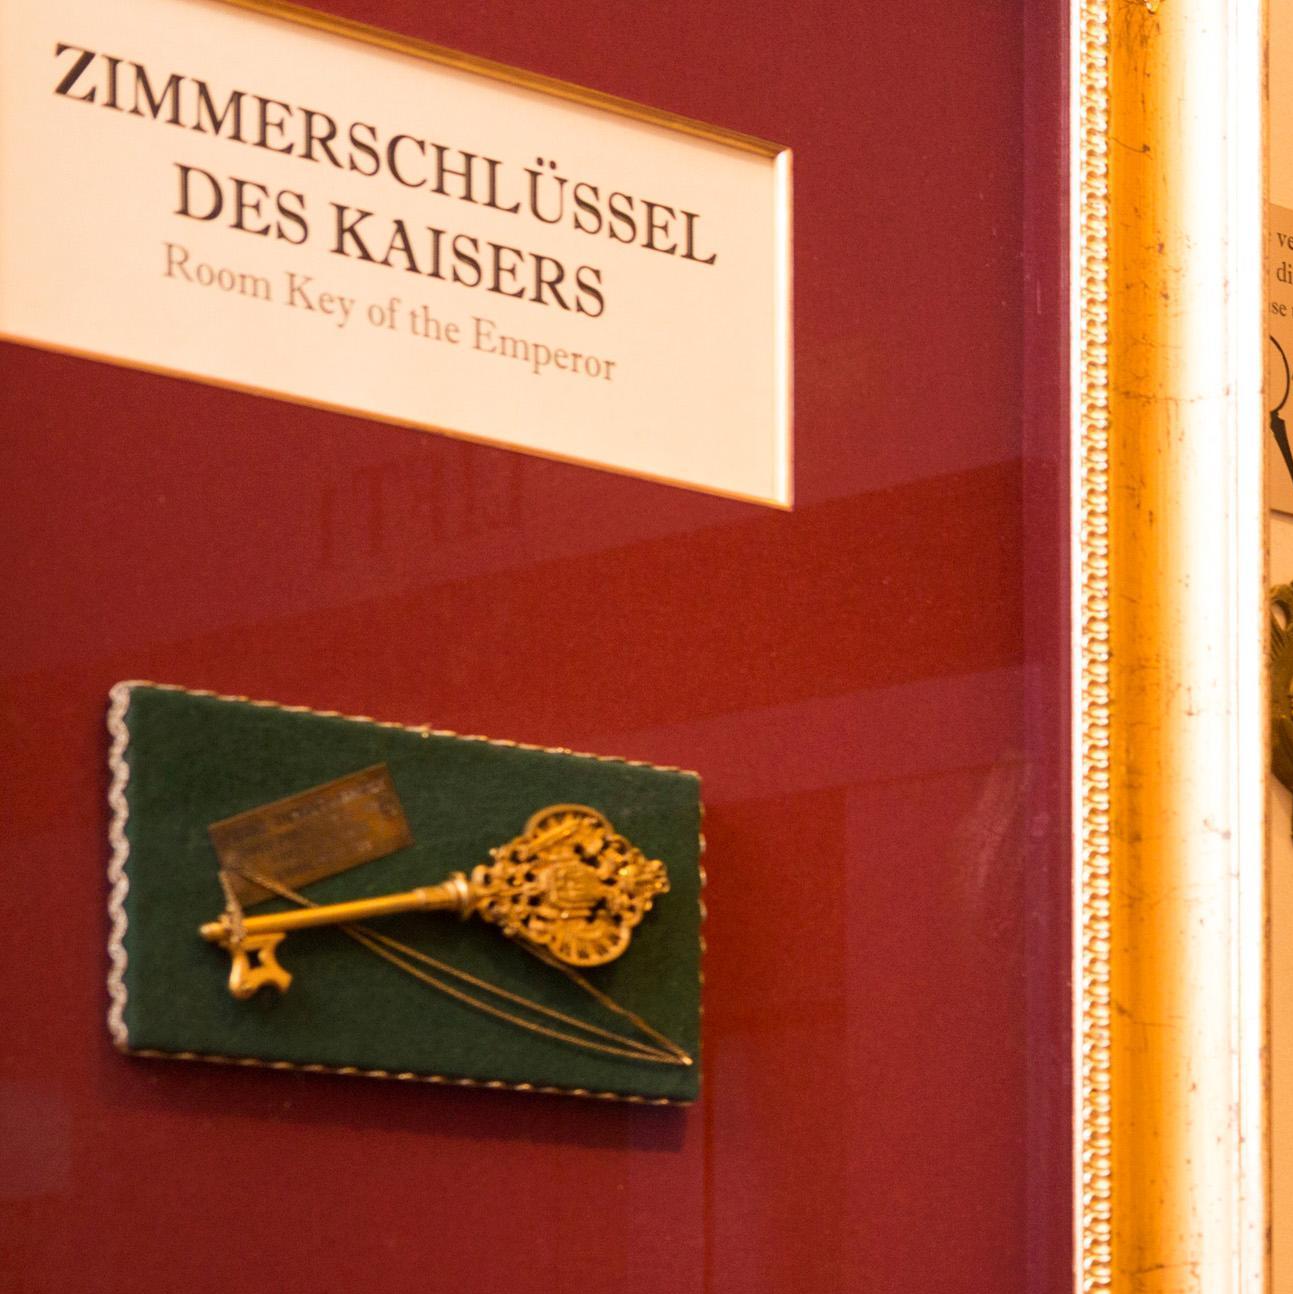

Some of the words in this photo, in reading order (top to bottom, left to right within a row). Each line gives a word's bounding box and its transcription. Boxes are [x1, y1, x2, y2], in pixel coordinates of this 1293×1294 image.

[54, 42, 717, 265] ZIMMERSCHLÜSSEL
[163, 242, 272, 300] Room
[285, 271, 356, 327] Key
[366, 297, 401, 330] of
[408, 304, 460, 344] the
[471, 316, 617, 379] Emperor
[174, 164, 309, 243] DES
[329, 205, 605, 315] KAISERS
